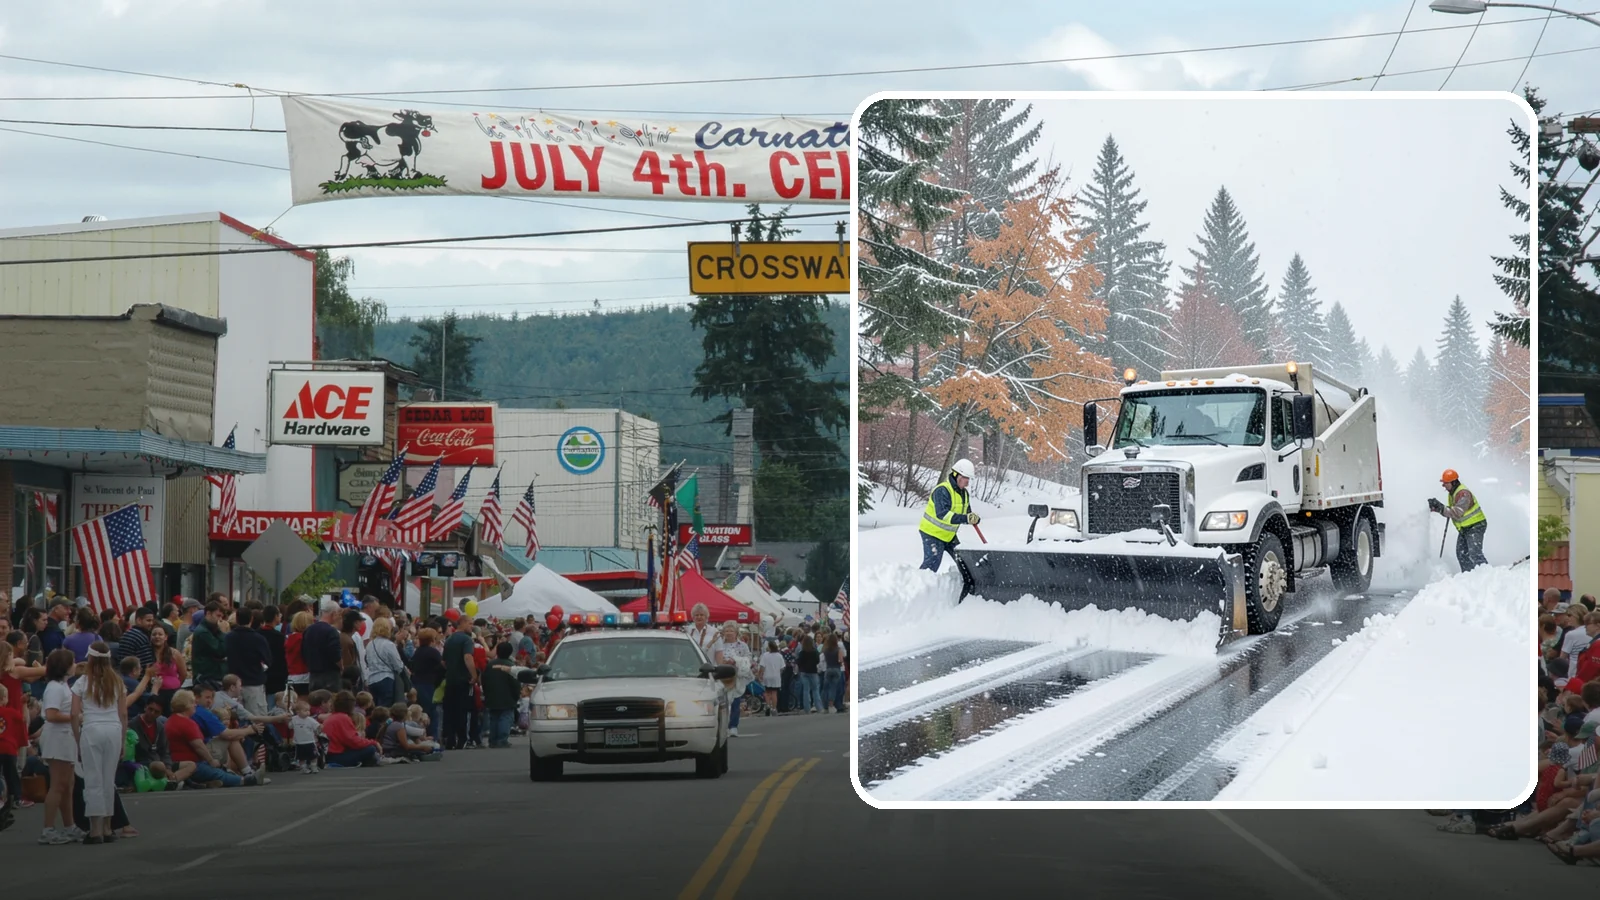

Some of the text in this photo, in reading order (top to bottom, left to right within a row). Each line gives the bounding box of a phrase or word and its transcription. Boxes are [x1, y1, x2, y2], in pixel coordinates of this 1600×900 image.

[481, 141, 605, 193] JULY
[632, 149, 746, 198] 4th.
[697, 254, 850, 280] CROSSWA
[283, 380, 374, 420] ACE
[405, 409, 453, 422] CEDAR
[283, 421, 371, 437] Hardware
[416, 428, 477, 447] Coca-Cola
[353, 467, 385, 481] Simpl
[83, 485, 155, 495] St. Vincent de Paul
[688, 526, 741, 535] CRNATION
[699, 535, 730, 543] GLASS
